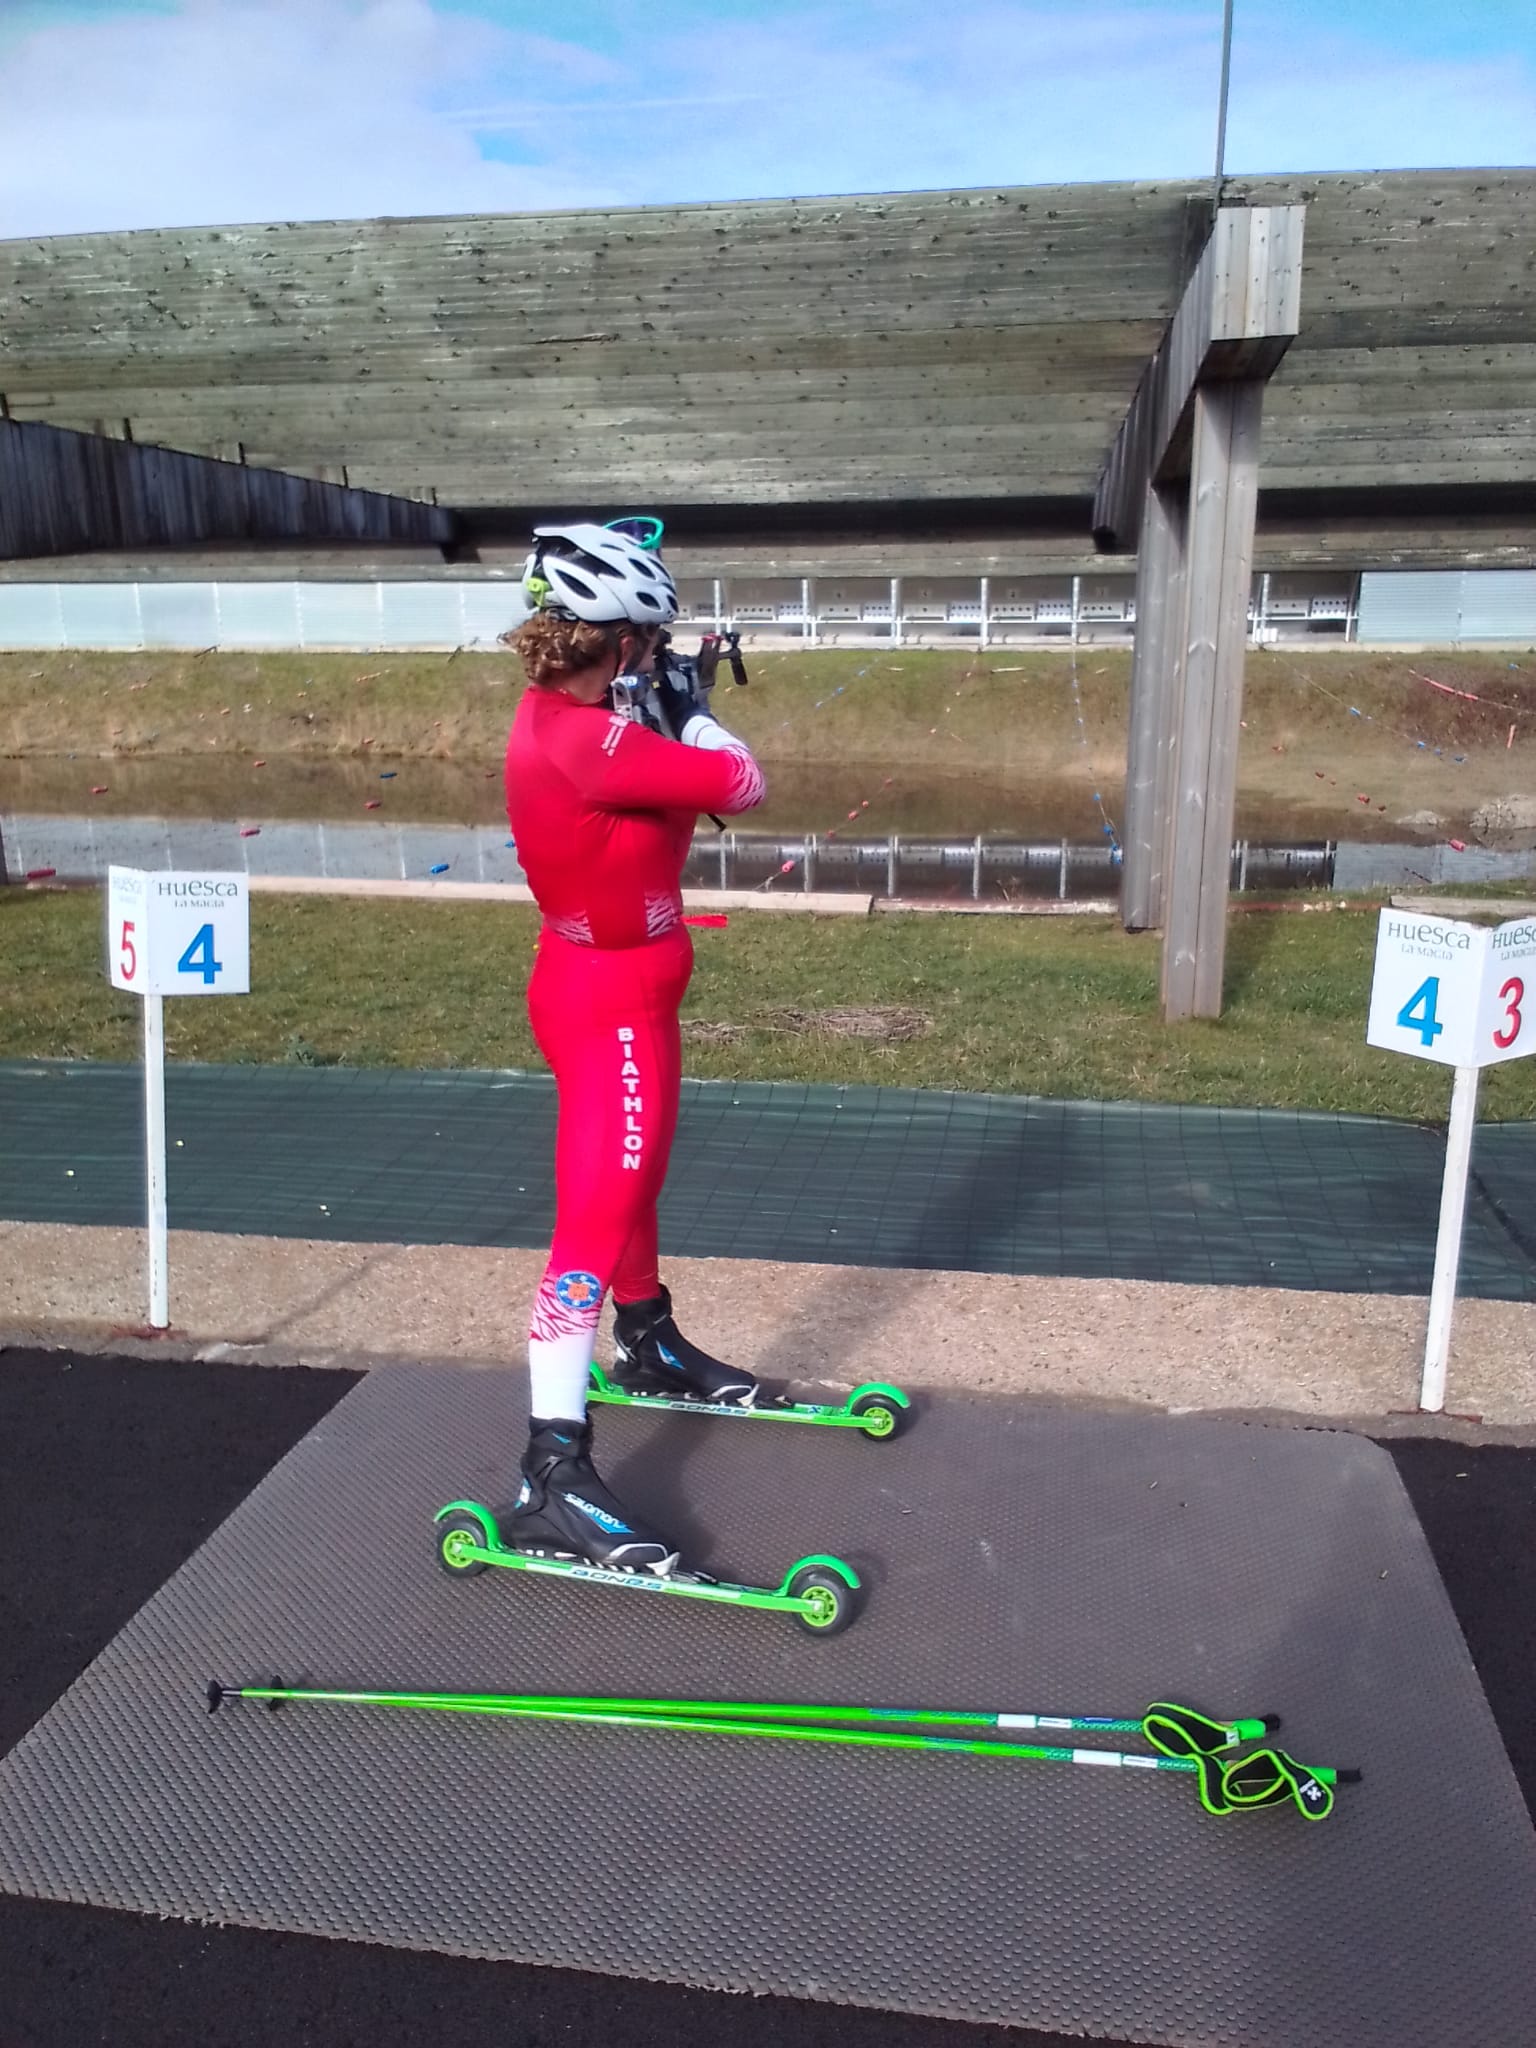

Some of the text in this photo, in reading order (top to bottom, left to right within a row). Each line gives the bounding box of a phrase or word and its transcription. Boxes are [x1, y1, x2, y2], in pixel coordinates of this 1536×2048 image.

[120, 919, 137, 981] 5
[177, 923, 223, 985] 4
[1396, 976, 1443, 1047] 4
[1493, 977, 1525, 1049] 3
[617, 1027, 643, 1170] BIATHLON
